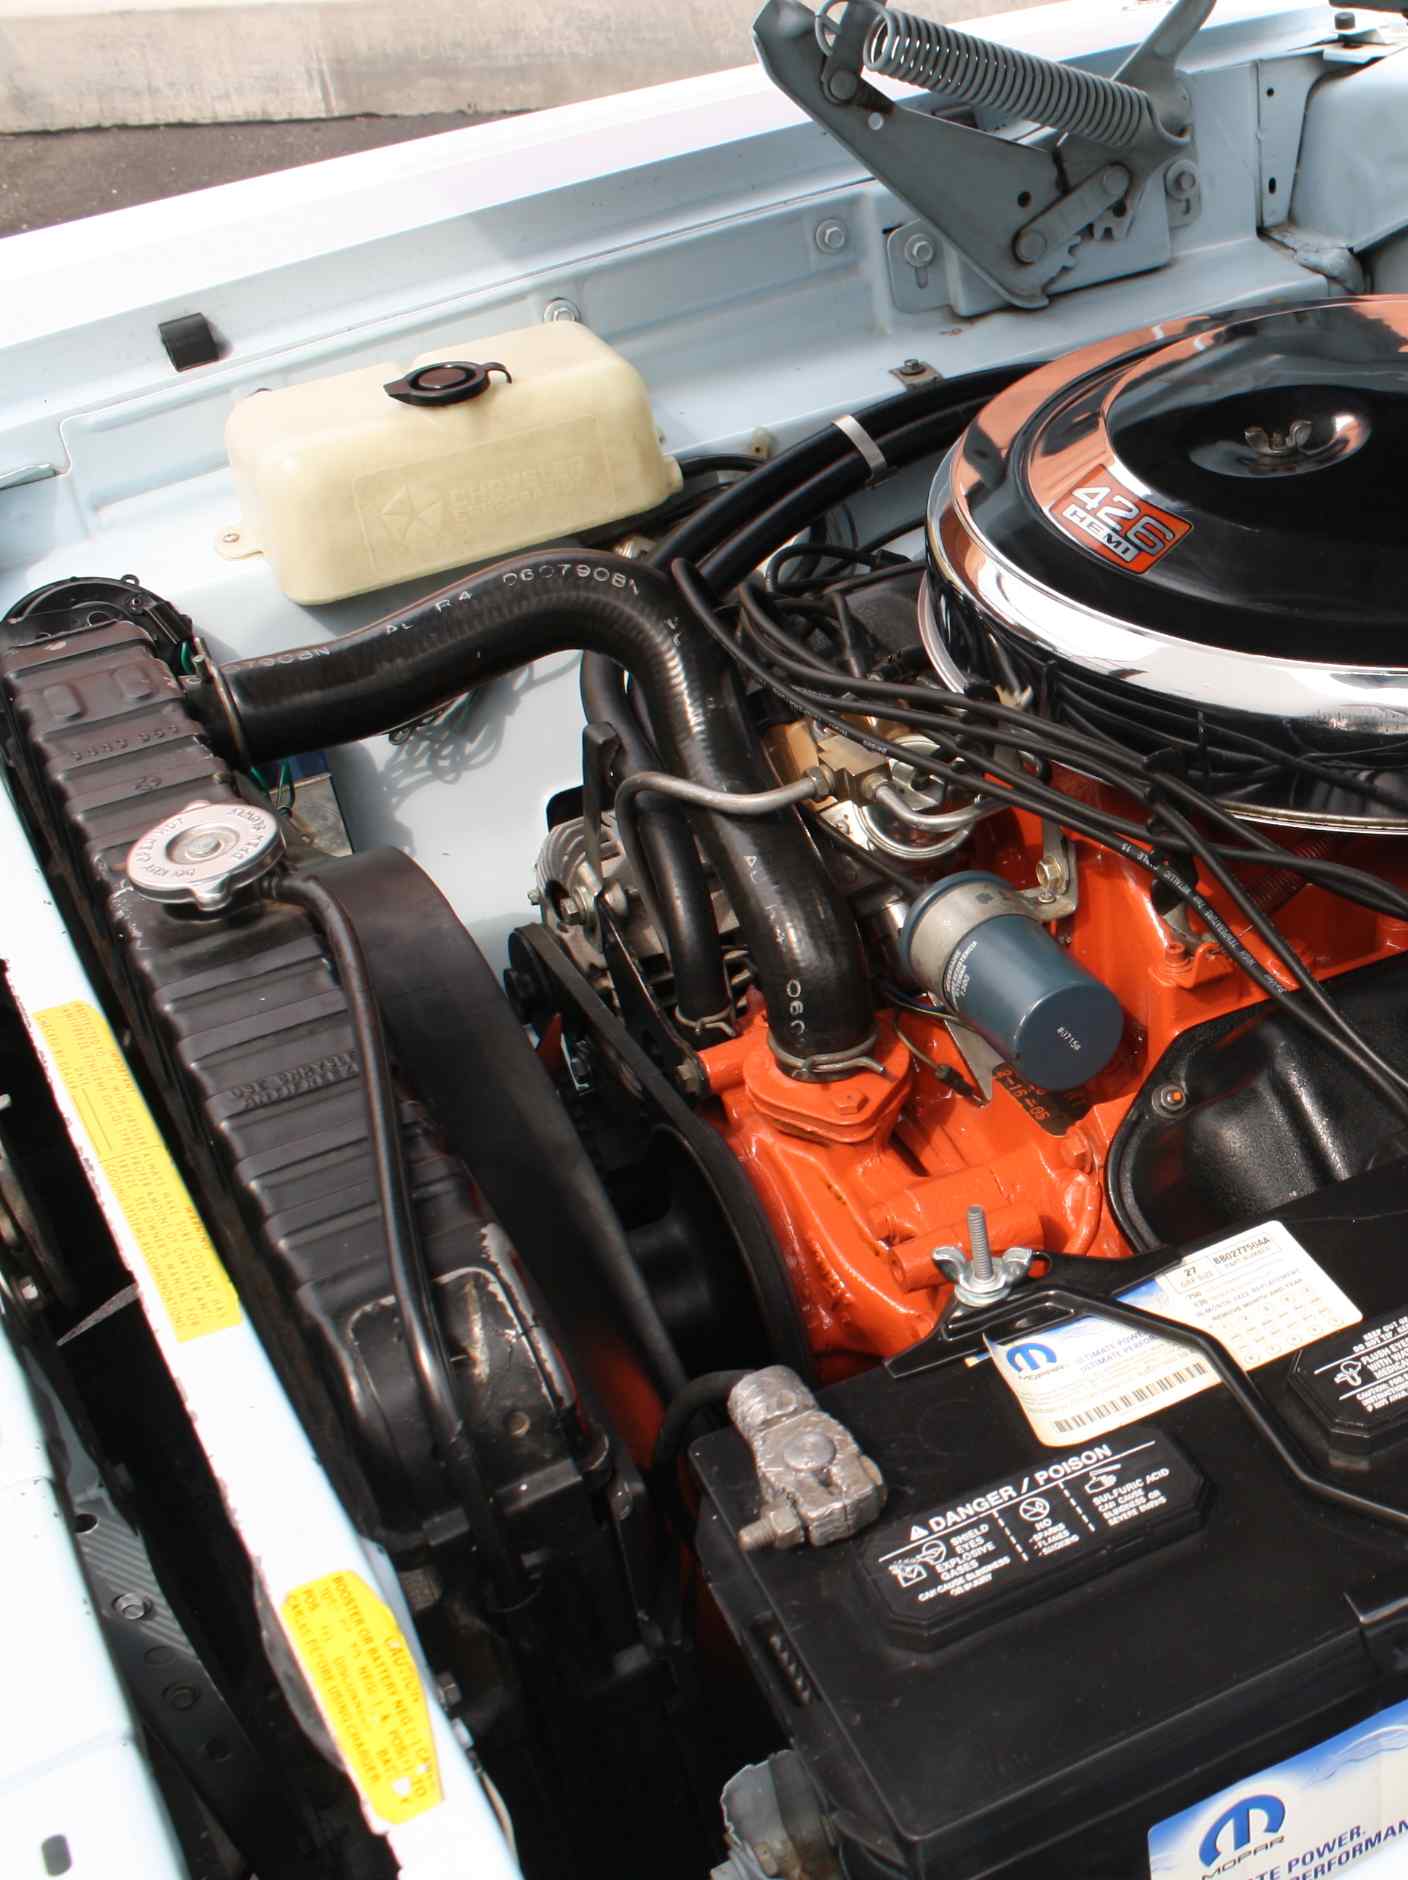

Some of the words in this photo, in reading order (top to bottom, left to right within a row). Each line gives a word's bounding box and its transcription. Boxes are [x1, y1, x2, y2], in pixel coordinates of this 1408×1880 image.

[1072, 486, 1176, 556] 426
[1068, 509, 1131, 557] HEMI
[1182, 1266, 1198, 1276] 27
[1362, 1327, 1382, 1340] KEEP
[1382, 1321, 1397, 1332] OUT
[1397, 1316, 1408, 1325] OF
[1352, 1343, 1365, 1352] DO
[1364, 1336, 1380, 1347] NOT
[1360, 1346, 1391, 1365] FLUSH
[1367, 1356, 1392, 1372] WITH
[1388, 1375, 1404, 1386] FOR
[1373, 1398, 1388, 1409] NOT
[927, 1485, 1017, 1531] DANGER
[1034, 1444, 1112, 1485] POISON
[1091, 1478, 1145, 1506] SULFURIC
[1143, 1467, 1171, 1483] ACID
[1146, 1489, 1162, 1500] OR
[1096, 1499, 1117, 1513] CAN
[1116, 1488, 1145, 1504] CAUSE
[949, 1523, 991, 1546] SHIELD
[1033, 1517, 1053, 1530] NO
[954, 1535, 985, 1553] EYES
[934, 1541, 997, 1573] EXPLOSIVE
[916, 1588, 937, 1602] CAN
[934, 1575, 966, 1594] CAUSE
[963, 1555, 1012, 1580] BLINDNESS
[939, 1559, 980, 1581] GASES
[332, 1574, 364, 1627] BOOSTER
[357, 1626, 374, 1645] OR
[366, 1645, 398, 1698] BATTERY
[1201, 1834, 1285, 1880] MOPAR
[1287, 1824, 1367, 1874] POWER.
